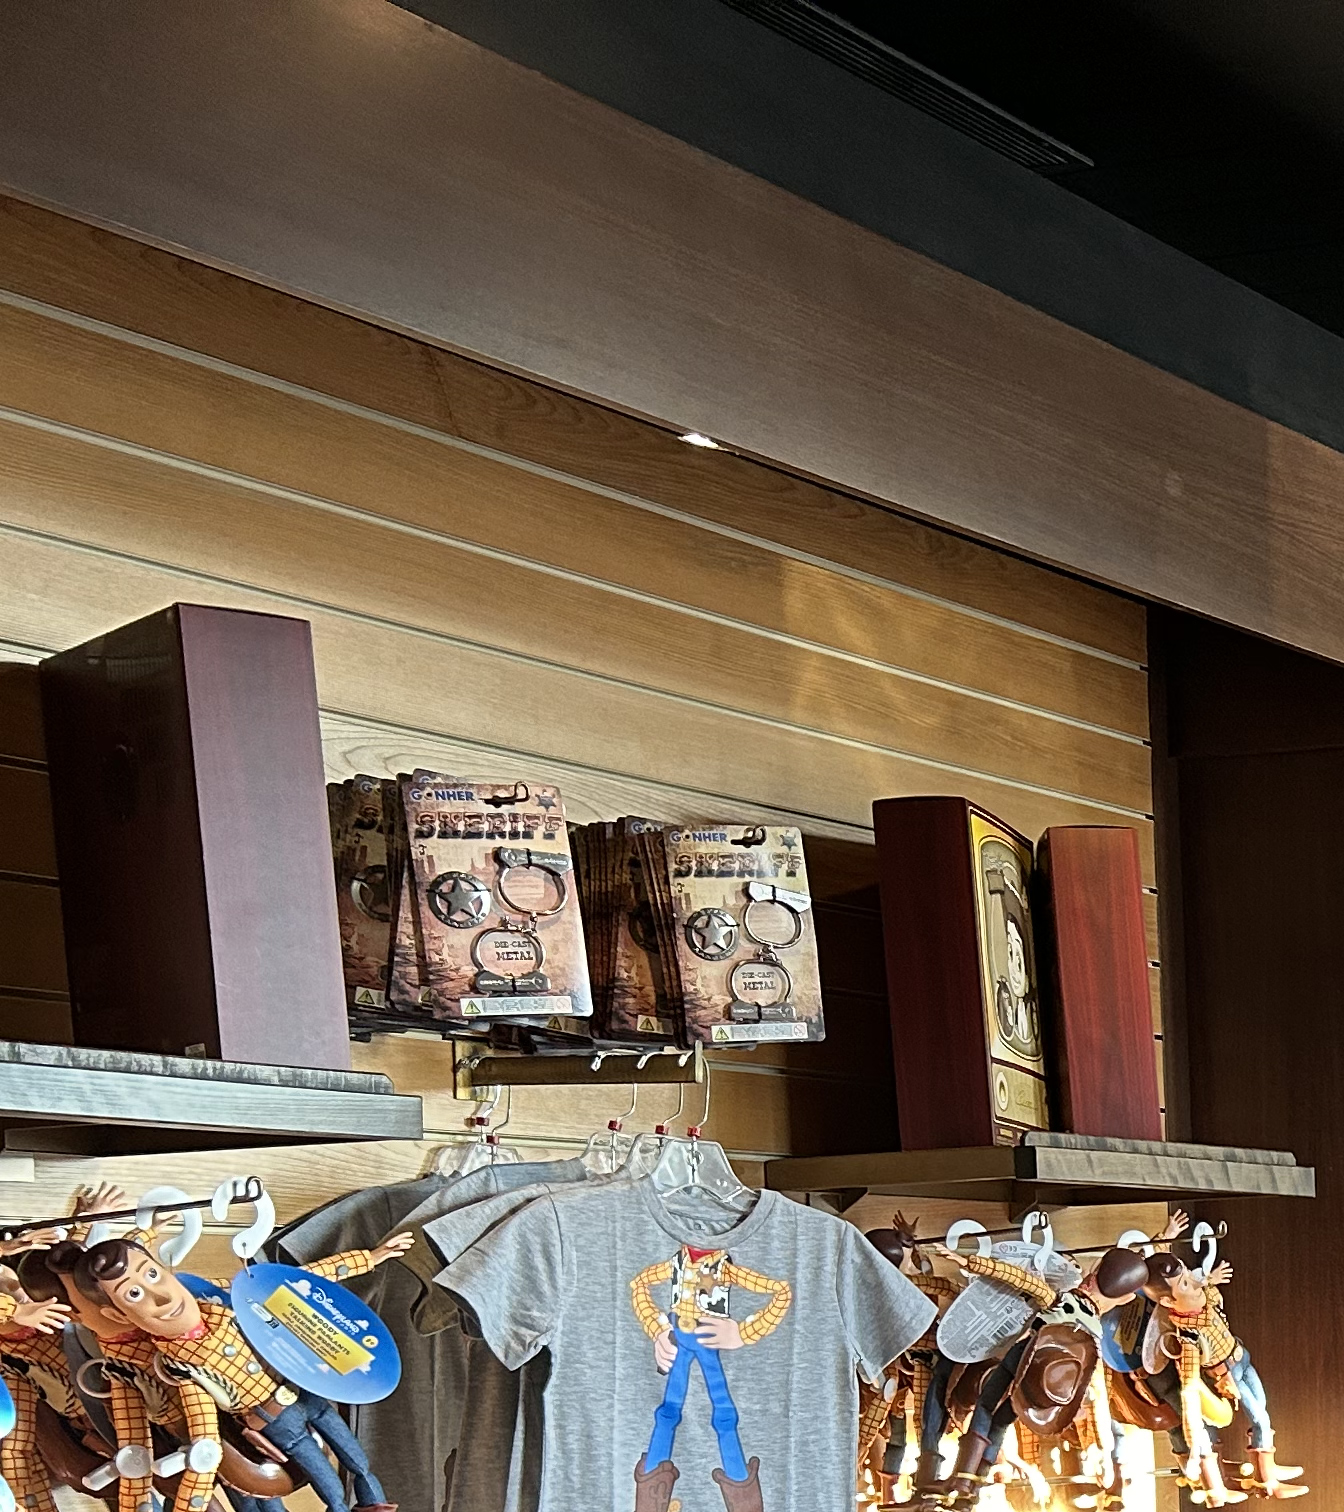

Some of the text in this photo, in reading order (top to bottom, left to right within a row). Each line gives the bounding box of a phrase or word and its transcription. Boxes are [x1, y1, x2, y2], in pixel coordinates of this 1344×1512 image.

[414, 811, 564, 840] SHERIFF
[496, 951, 534, 961] METAL
[311, 1312, 340, 1337] WOODY
